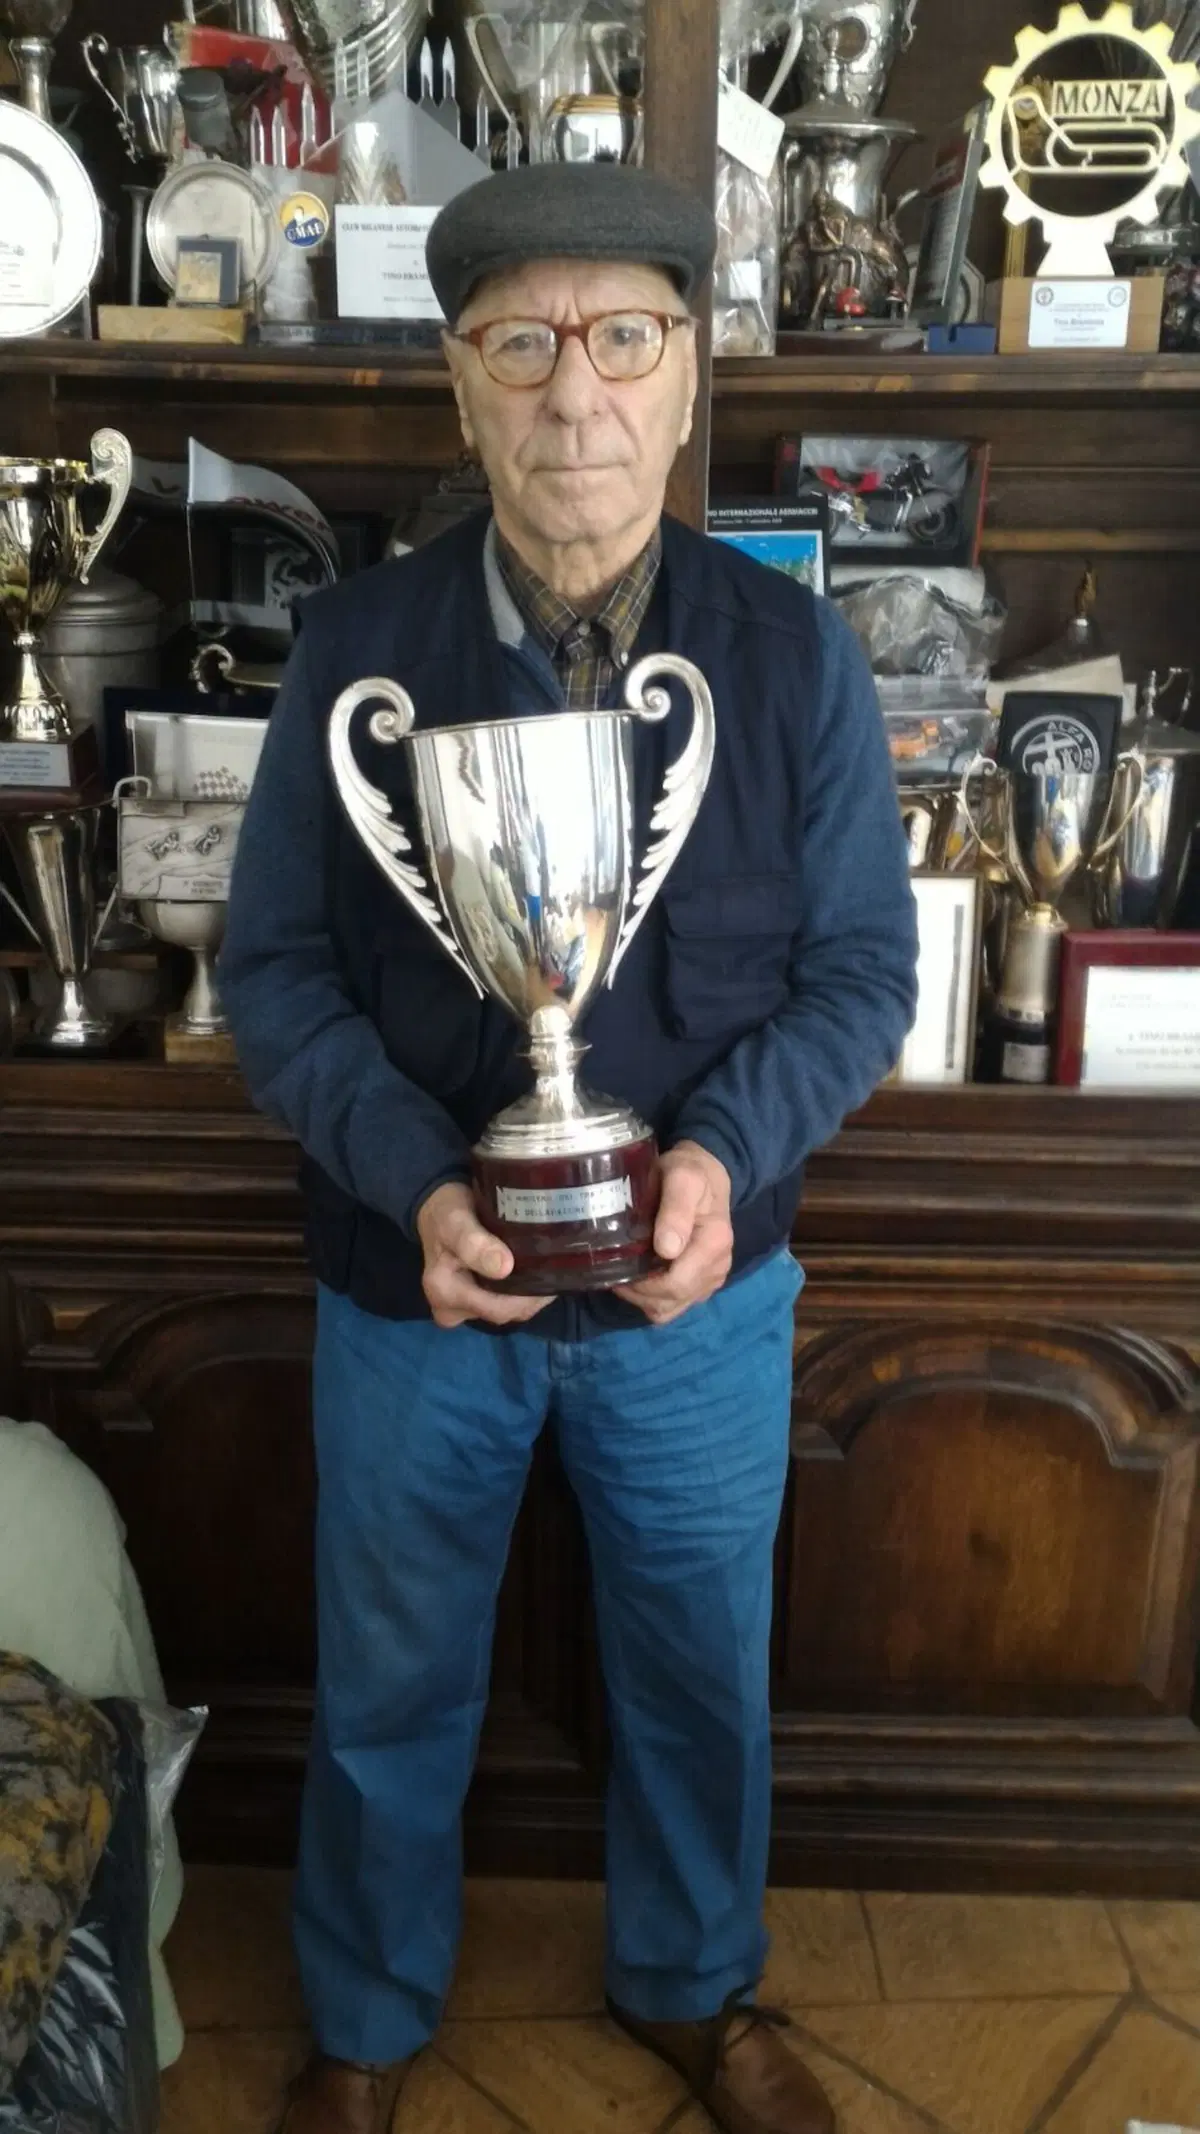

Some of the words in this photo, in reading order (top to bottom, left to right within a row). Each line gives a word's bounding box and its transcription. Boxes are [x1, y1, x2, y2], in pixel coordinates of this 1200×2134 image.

[1056, 83, 1161, 113] MONZA
[719, 508, 778, 517] INTERNAZIONALE
[779, 507, 819, 516] AERMACCHI
[1047, 720, 1085, 744] ALFA
[1082, 747, 1093, 772] RO
